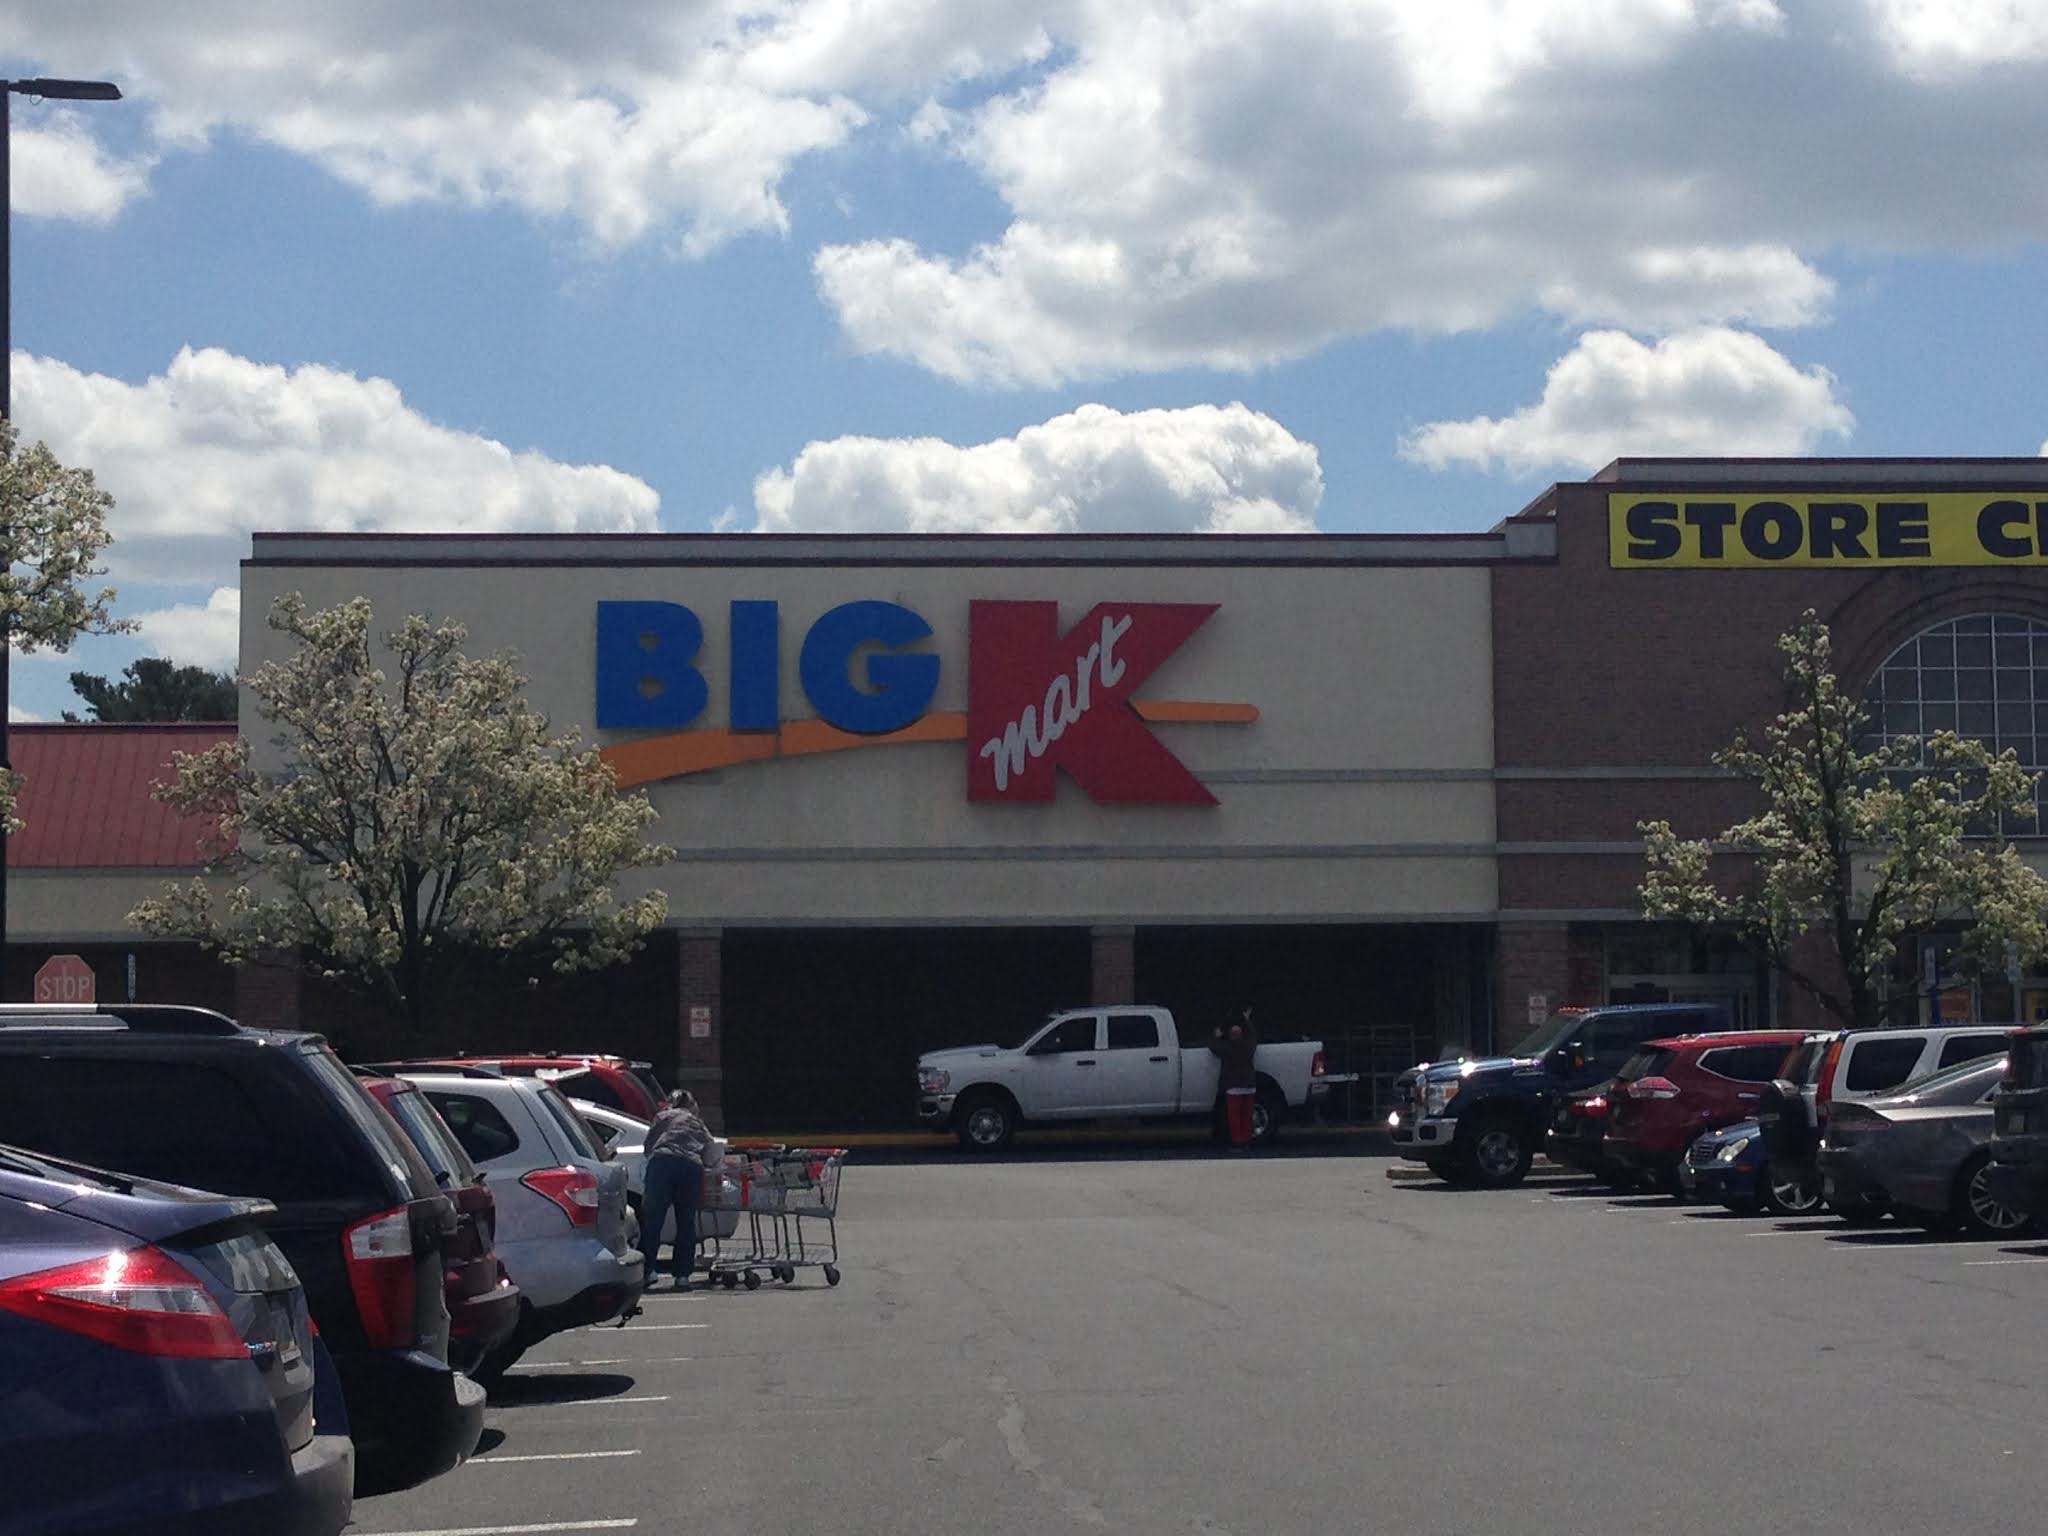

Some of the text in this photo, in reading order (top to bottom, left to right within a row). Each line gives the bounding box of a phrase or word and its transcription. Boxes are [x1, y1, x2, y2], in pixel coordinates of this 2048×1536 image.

[1626, 500, 2048, 560] STORE C
[596, 600, 1221, 805] BIG K
[980, 615, 1132, 790] mart
[40, 975, 90, 1001] STOP
